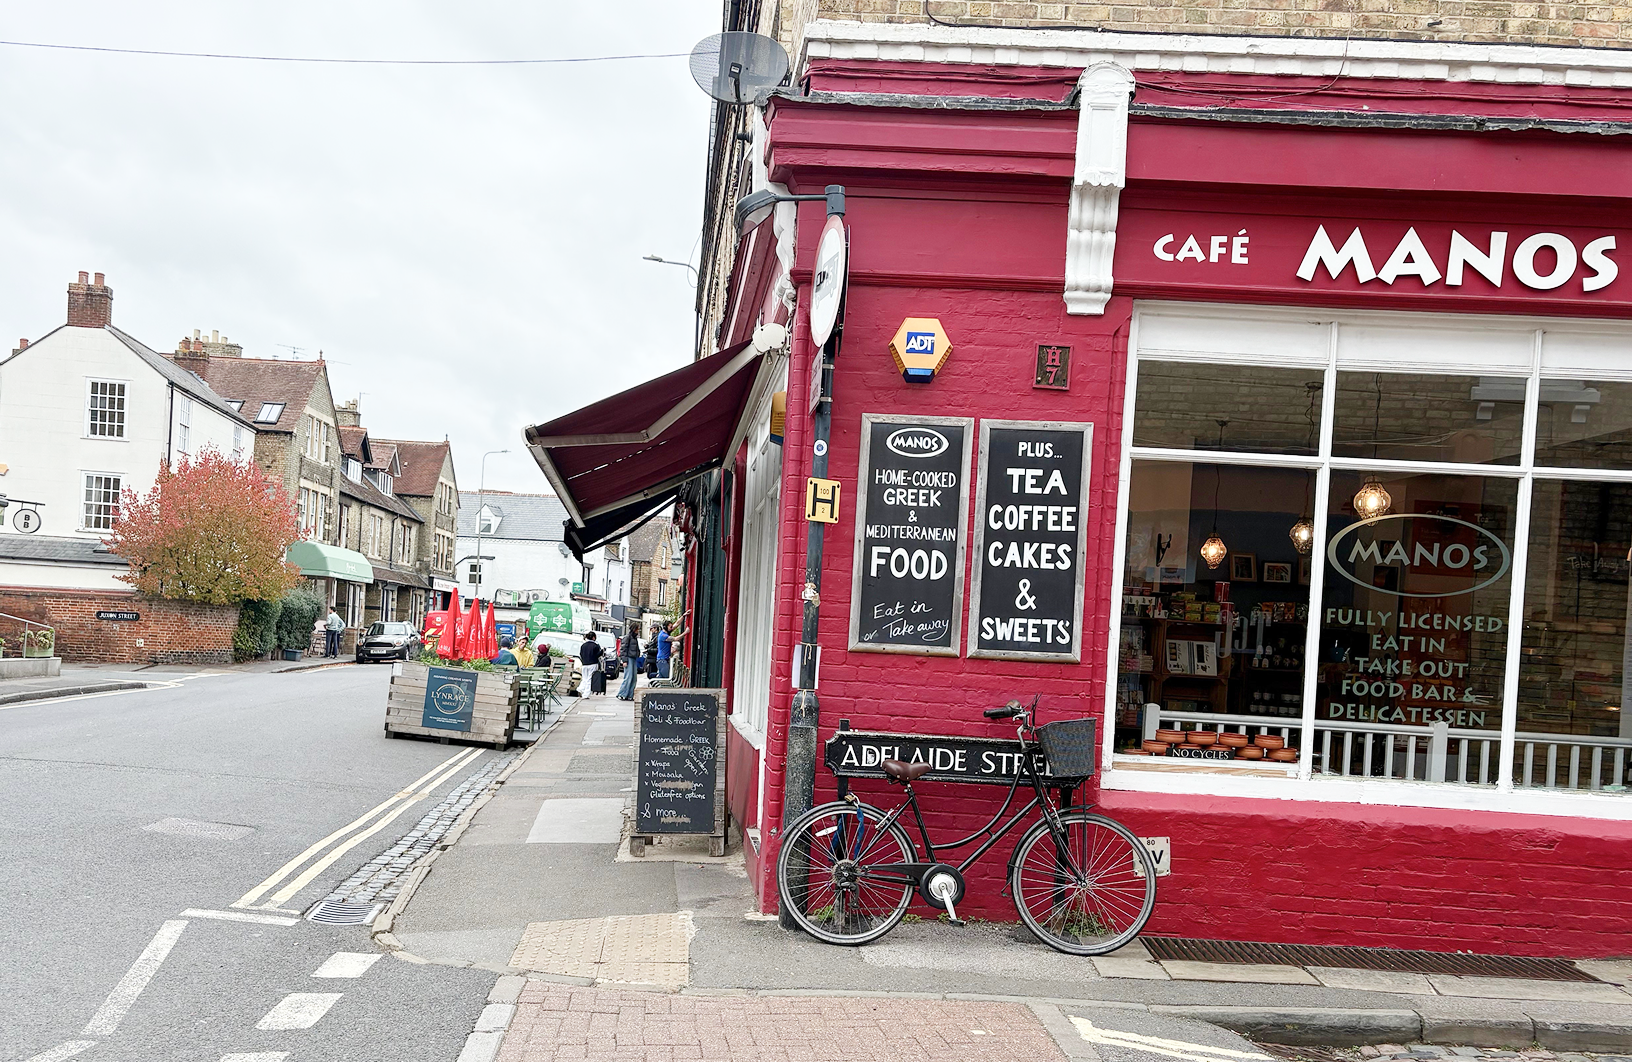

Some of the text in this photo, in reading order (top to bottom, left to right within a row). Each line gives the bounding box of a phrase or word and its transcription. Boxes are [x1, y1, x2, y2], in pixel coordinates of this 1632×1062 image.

[1153, 228, 1250, 266] CAFÉ
[1296, 225, 1619, 292] MANOS
[905, 333, 935, 351] ADT
[1046, 367, 1059, 385] 7
[893, 435, 940, 452] MANOS
[874, 468, 957, 489] HOME-COOKED
[1006, 468, 1068, 495] TEA
[883, 488, 942, 508] GREEK
[908, 510, 918, 523] &
[988, 504, 1077, 533] COFFEE
[865, 523, 957, 543] MEDITERRANEAN
[870, 545, 948, 581] FOOD
[987, 542, 1073, 571] CAKES
[1347, 539, 1489, 571] MANOS
[1014, 578, 1037, 611] &
[873, 601, 933, 620] Eat in
[1326, 608, 1504, 634] FULLY LICENSED
[883, 619, 916, 640] Take
[917, 619, 950, 644] away
[1371, 634, 1446, 654] EAT IN
[1354, 657, 1470, 679] TAKE OUT
[431, 691, 470, 702] LYNRACE
[1341, 681, 1477, 702] FOOD BAR &
[684, 701, 707, 711] Greek
[1329, 703, 1485, 727] DELICATESSEN
[648, 714, 663, 723] Deli
[644, 734, 684, 743] Homemade
[1172, 749, 1229, 760] NO CYCLES
